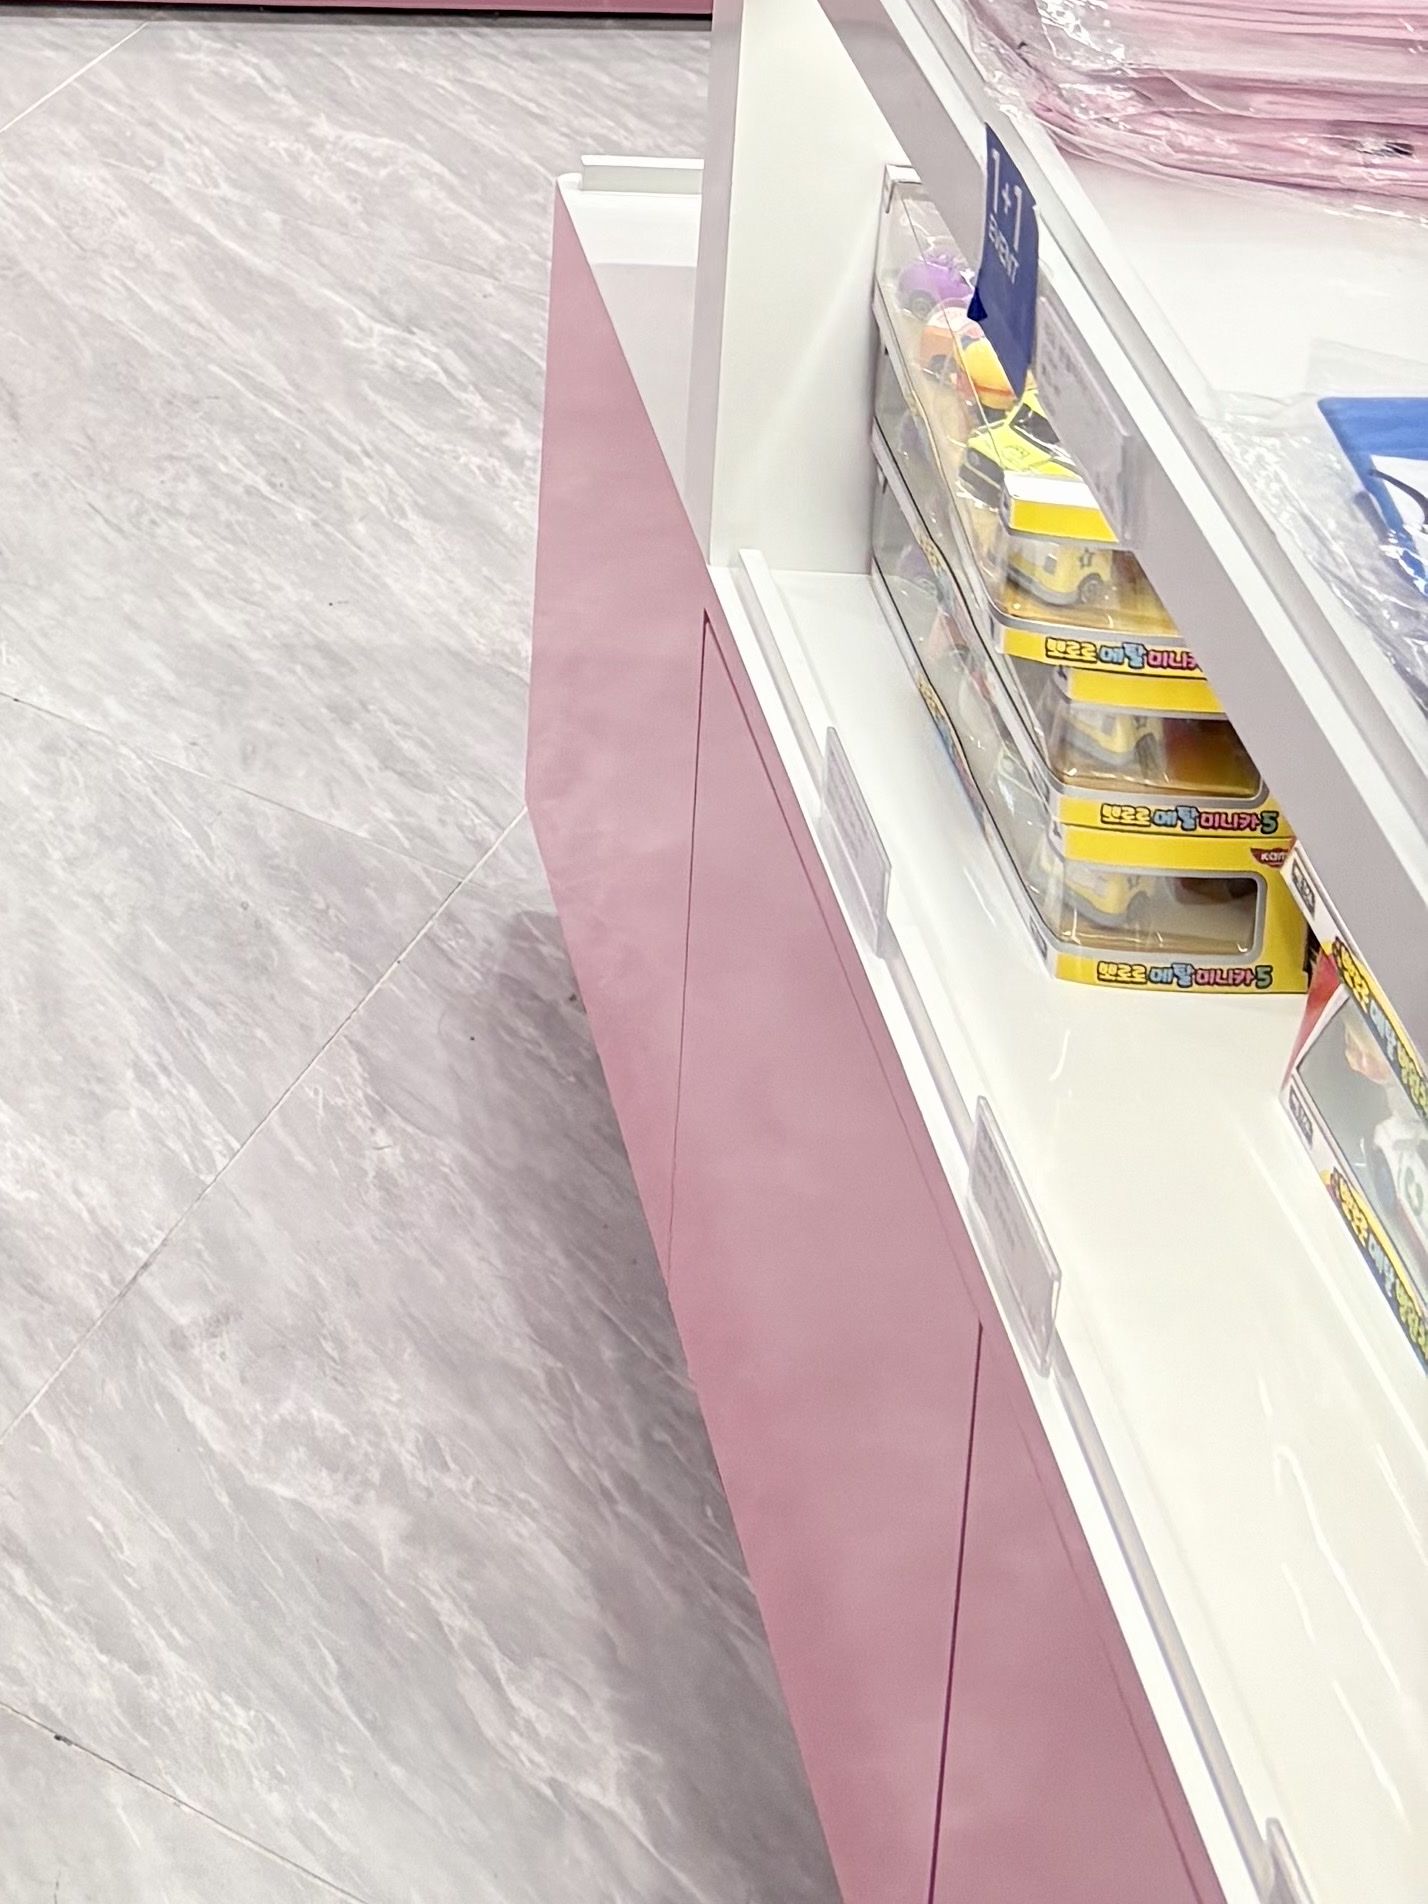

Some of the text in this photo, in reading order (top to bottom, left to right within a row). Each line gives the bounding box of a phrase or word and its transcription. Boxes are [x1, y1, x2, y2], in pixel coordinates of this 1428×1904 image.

[991, 147, 1023, 253] 1+1
[988, 213, 1019, 285] EVENT
[1045, 637, 1099, 664] 뽀로로
[1099, 802, 1151, 827] 뽀로로
[1096, 960, 1147, 984] 뽀로로
